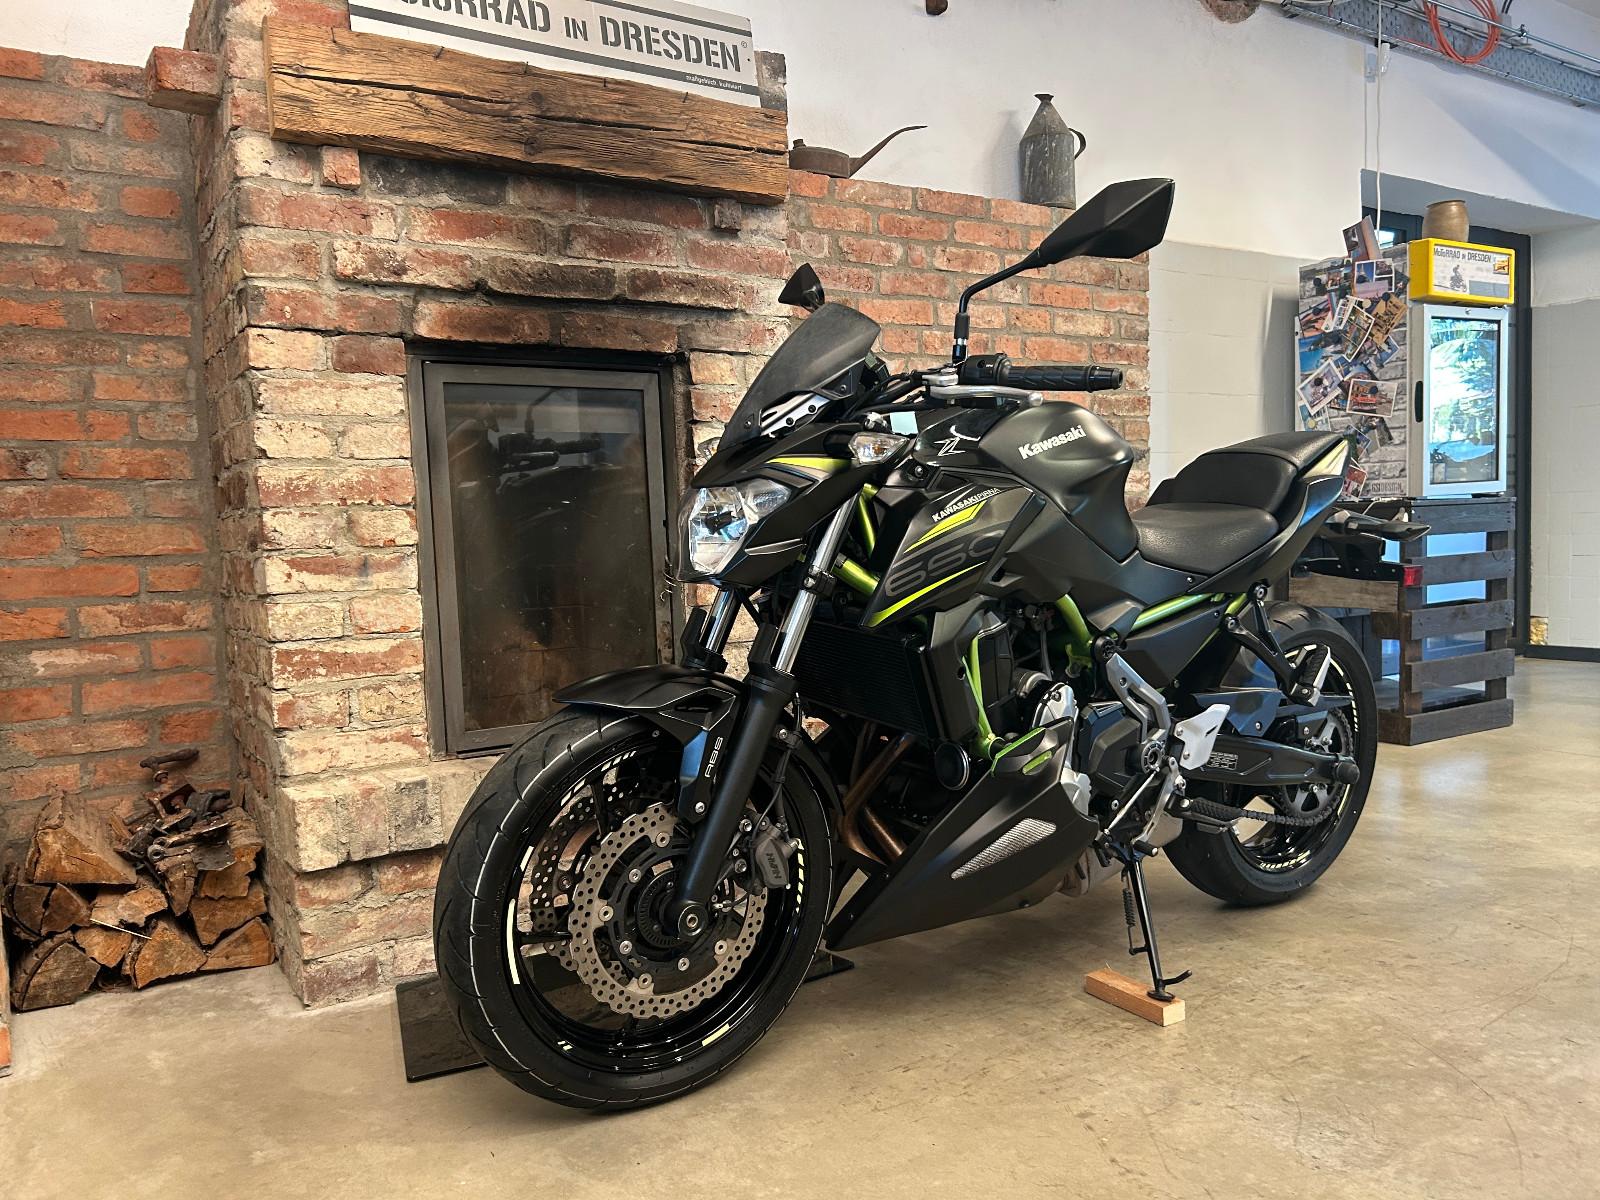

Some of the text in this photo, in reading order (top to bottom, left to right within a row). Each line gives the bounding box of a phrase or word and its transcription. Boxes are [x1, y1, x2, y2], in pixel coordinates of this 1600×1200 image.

[563, 16, 589, 42] IN
[599, 15, 742, 73] DRESDEN
[1467, 252, 1492, 263] DRESDEN
[1018, 424, 1087, 460] Kawasaki
[704, 736, 724, 778] ABS
